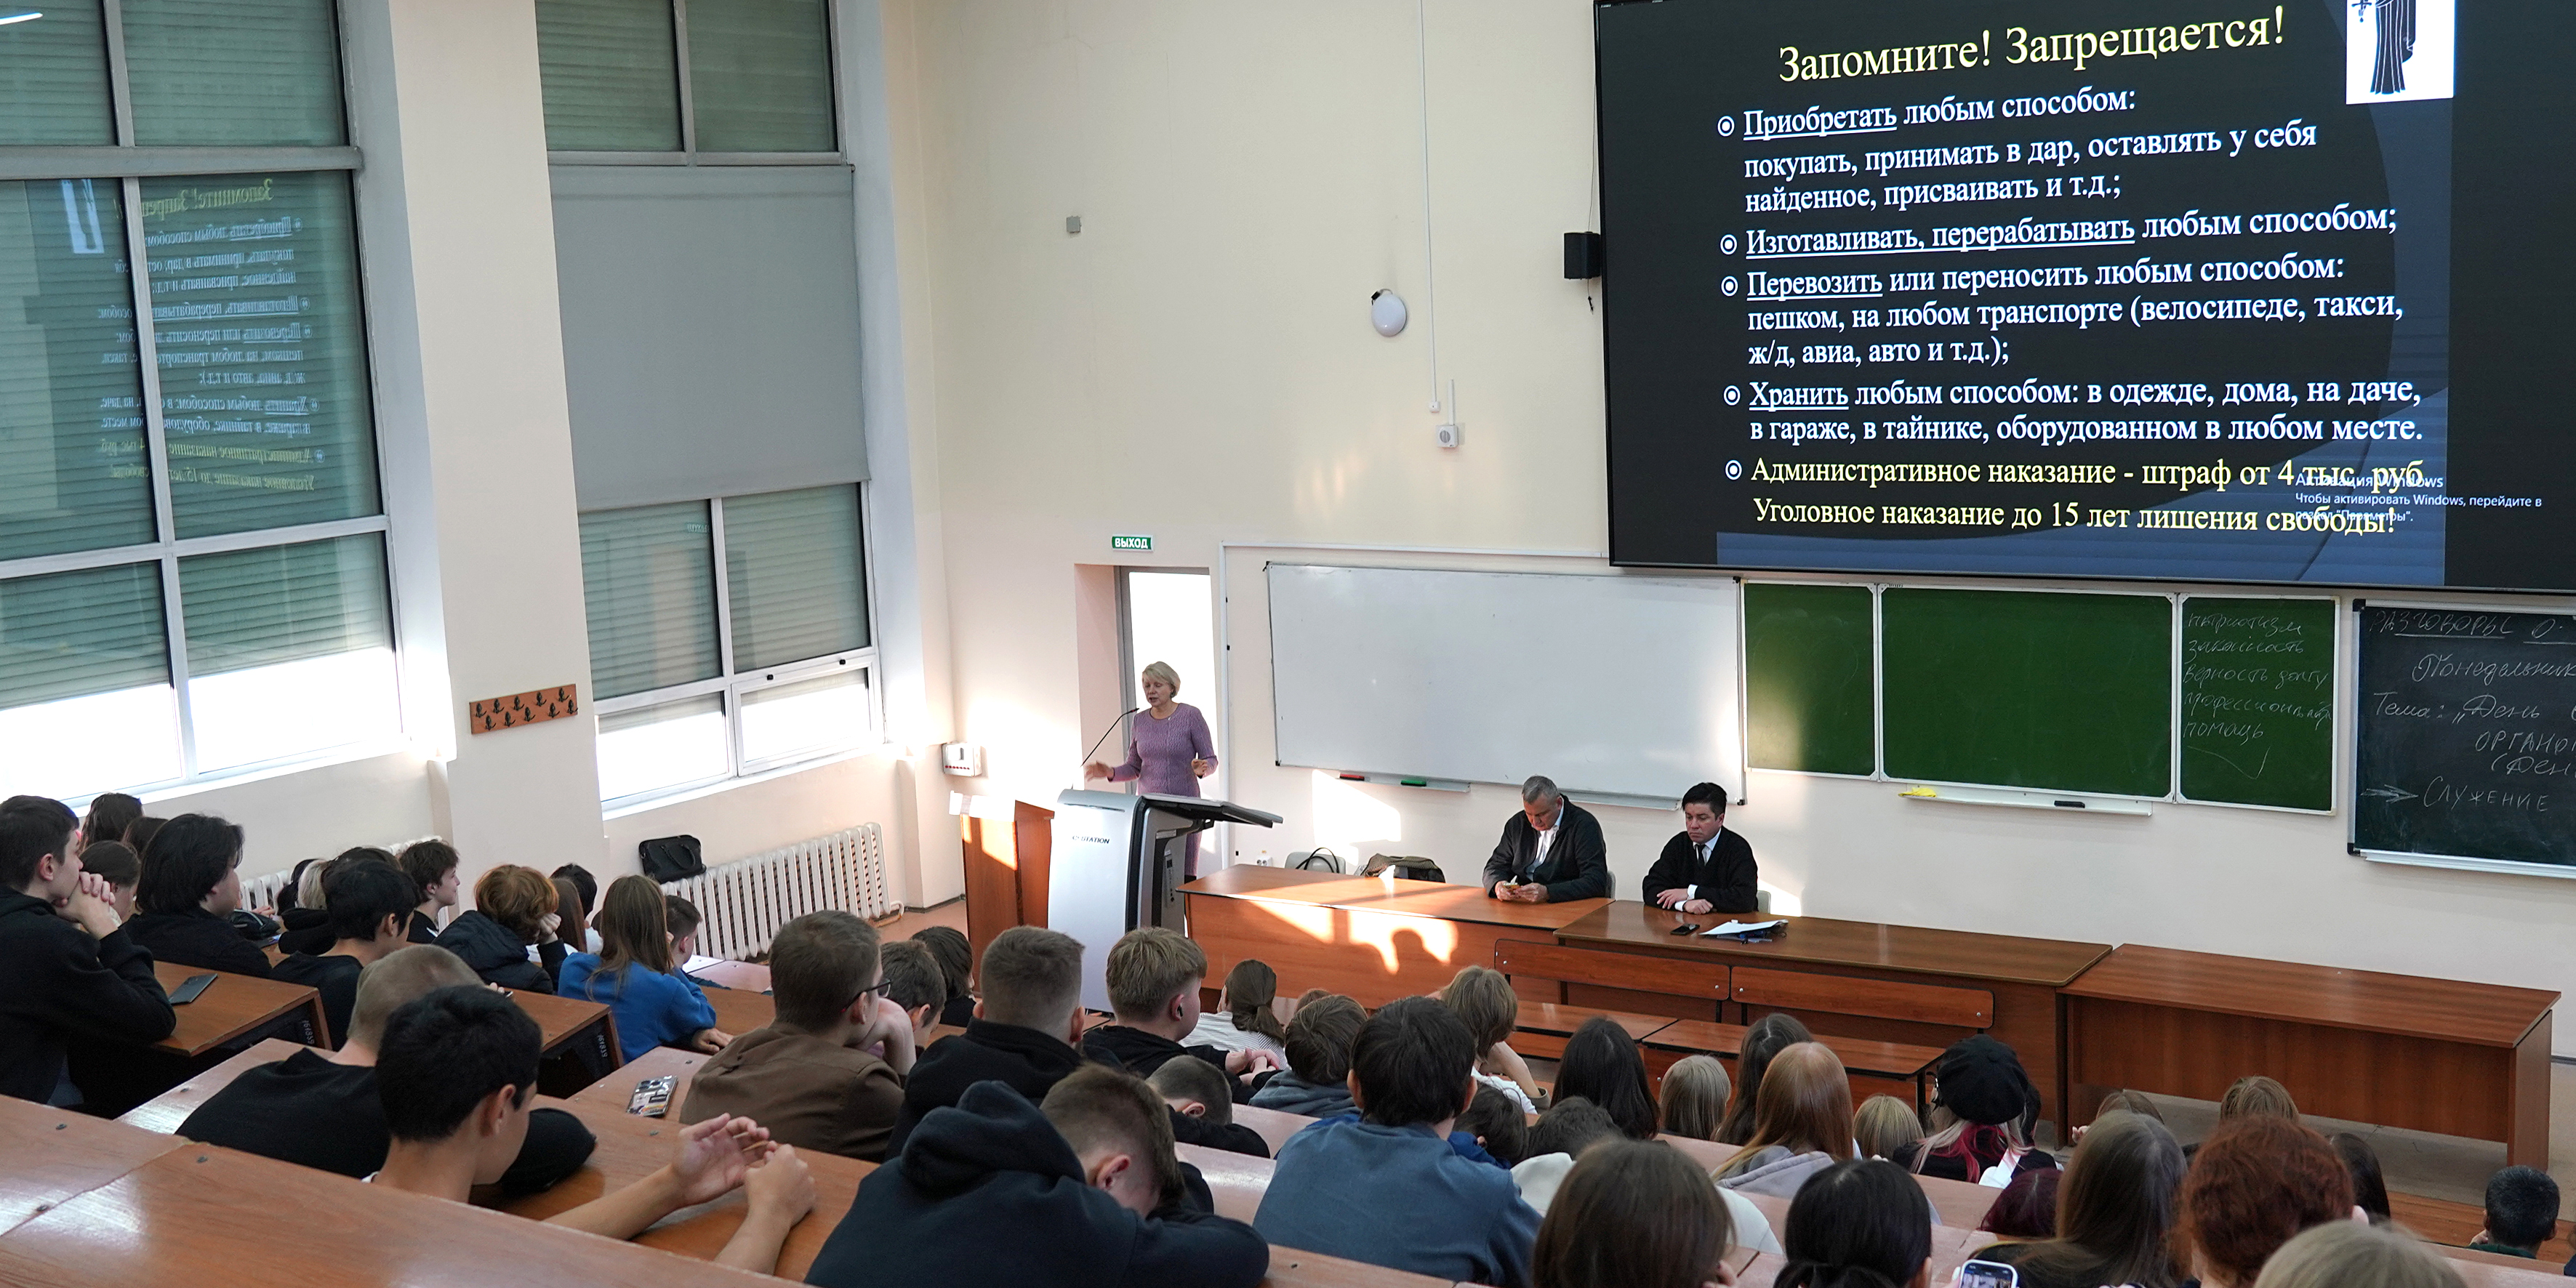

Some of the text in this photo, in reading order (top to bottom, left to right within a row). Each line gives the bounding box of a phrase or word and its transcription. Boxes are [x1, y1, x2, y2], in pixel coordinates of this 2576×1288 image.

[1780, 6, 2283, 81] Запомните! Запрещается!
[1744, 86, 2135, 140] Приобретать любым способом:
[1745, 118, 2316, 181] покупать, принимать в дар, оставлять у себя
[1746, 175, 2120, 213] найденное, присваивать и т.д.;
[1746, 203, 2396, 259] Изготавливать, перерабатывать любым способом;
[1747, 252, 2343, 301] Перевозить или переносить любым способом:
[1749, 296, 2402, 332] пешком, на любом транспорте (велосипеде, такси,
[1749, 336, 2008, 368] ж/д, авиа, авто и т.д.);
[1749, 378, 2420, 411] Хранить любым способом: в одежде, дома, на даче,
[1751, 414, 2422, 446] в гараже, в тайнике, оборудованном в любом месте.
[1752, 458, 1980, 488] Административное
[1989, 465, 2115, 483] наказание
[2143, 459, 2231, 491] штраф
[2240, 467, 2270, 485] от
[2278, 460, 2294, 485] 4
[2371, 460, 2430, 494] руб.
[1754, 499, 2396, 536] Уголовное наказание до 15 лет лишения свободы!
[2295, 493, 2331, 505] Чтобы
[2334, 495, 2410, 507] активировать
[2413, 494, 2465, 507] Windows,
[2469, 496, 2532, 508] перейдите
[1115, 538, 1149, 549] ВЫХОД
